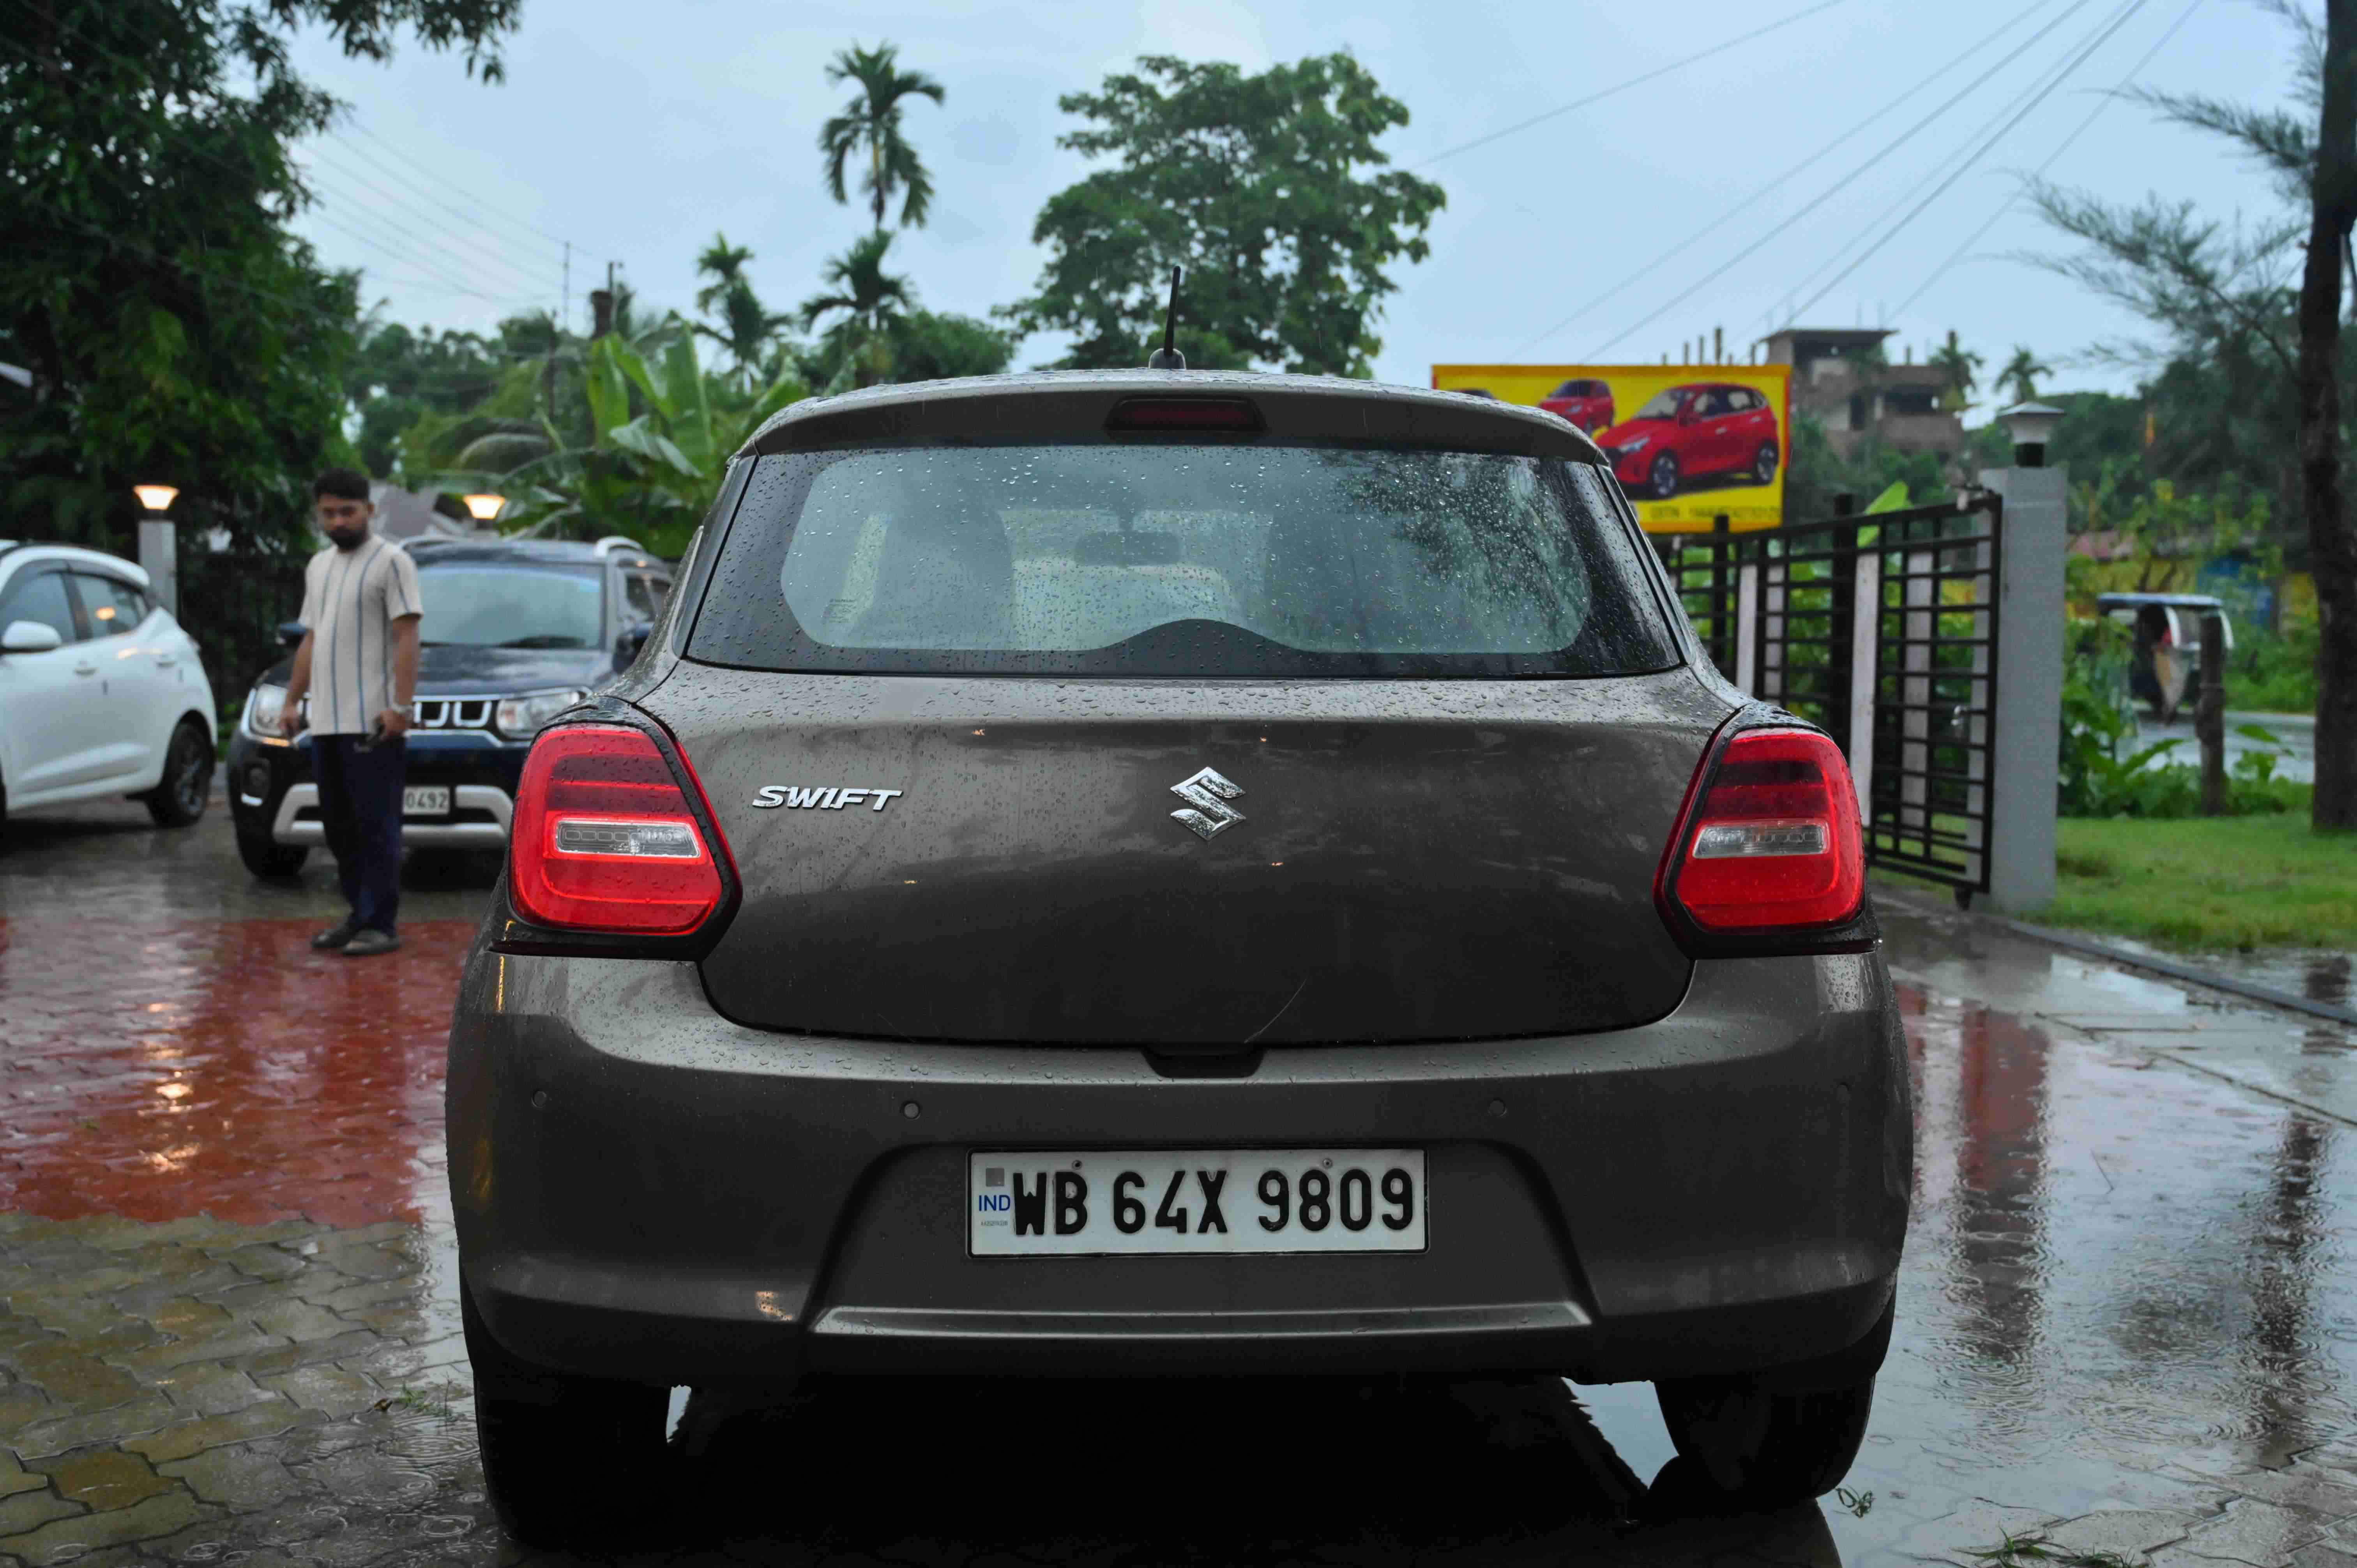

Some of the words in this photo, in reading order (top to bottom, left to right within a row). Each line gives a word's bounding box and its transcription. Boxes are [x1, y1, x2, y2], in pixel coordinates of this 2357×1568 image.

[752, 785, 903, 811] SWIFT
[979, 1195, 1011, 1211] IND
[1013, 1171, 1088, 1236] WB
[1113, 1170, 1228, 1234] 64X
[1258, 1168, 1413, 1232] 9809
